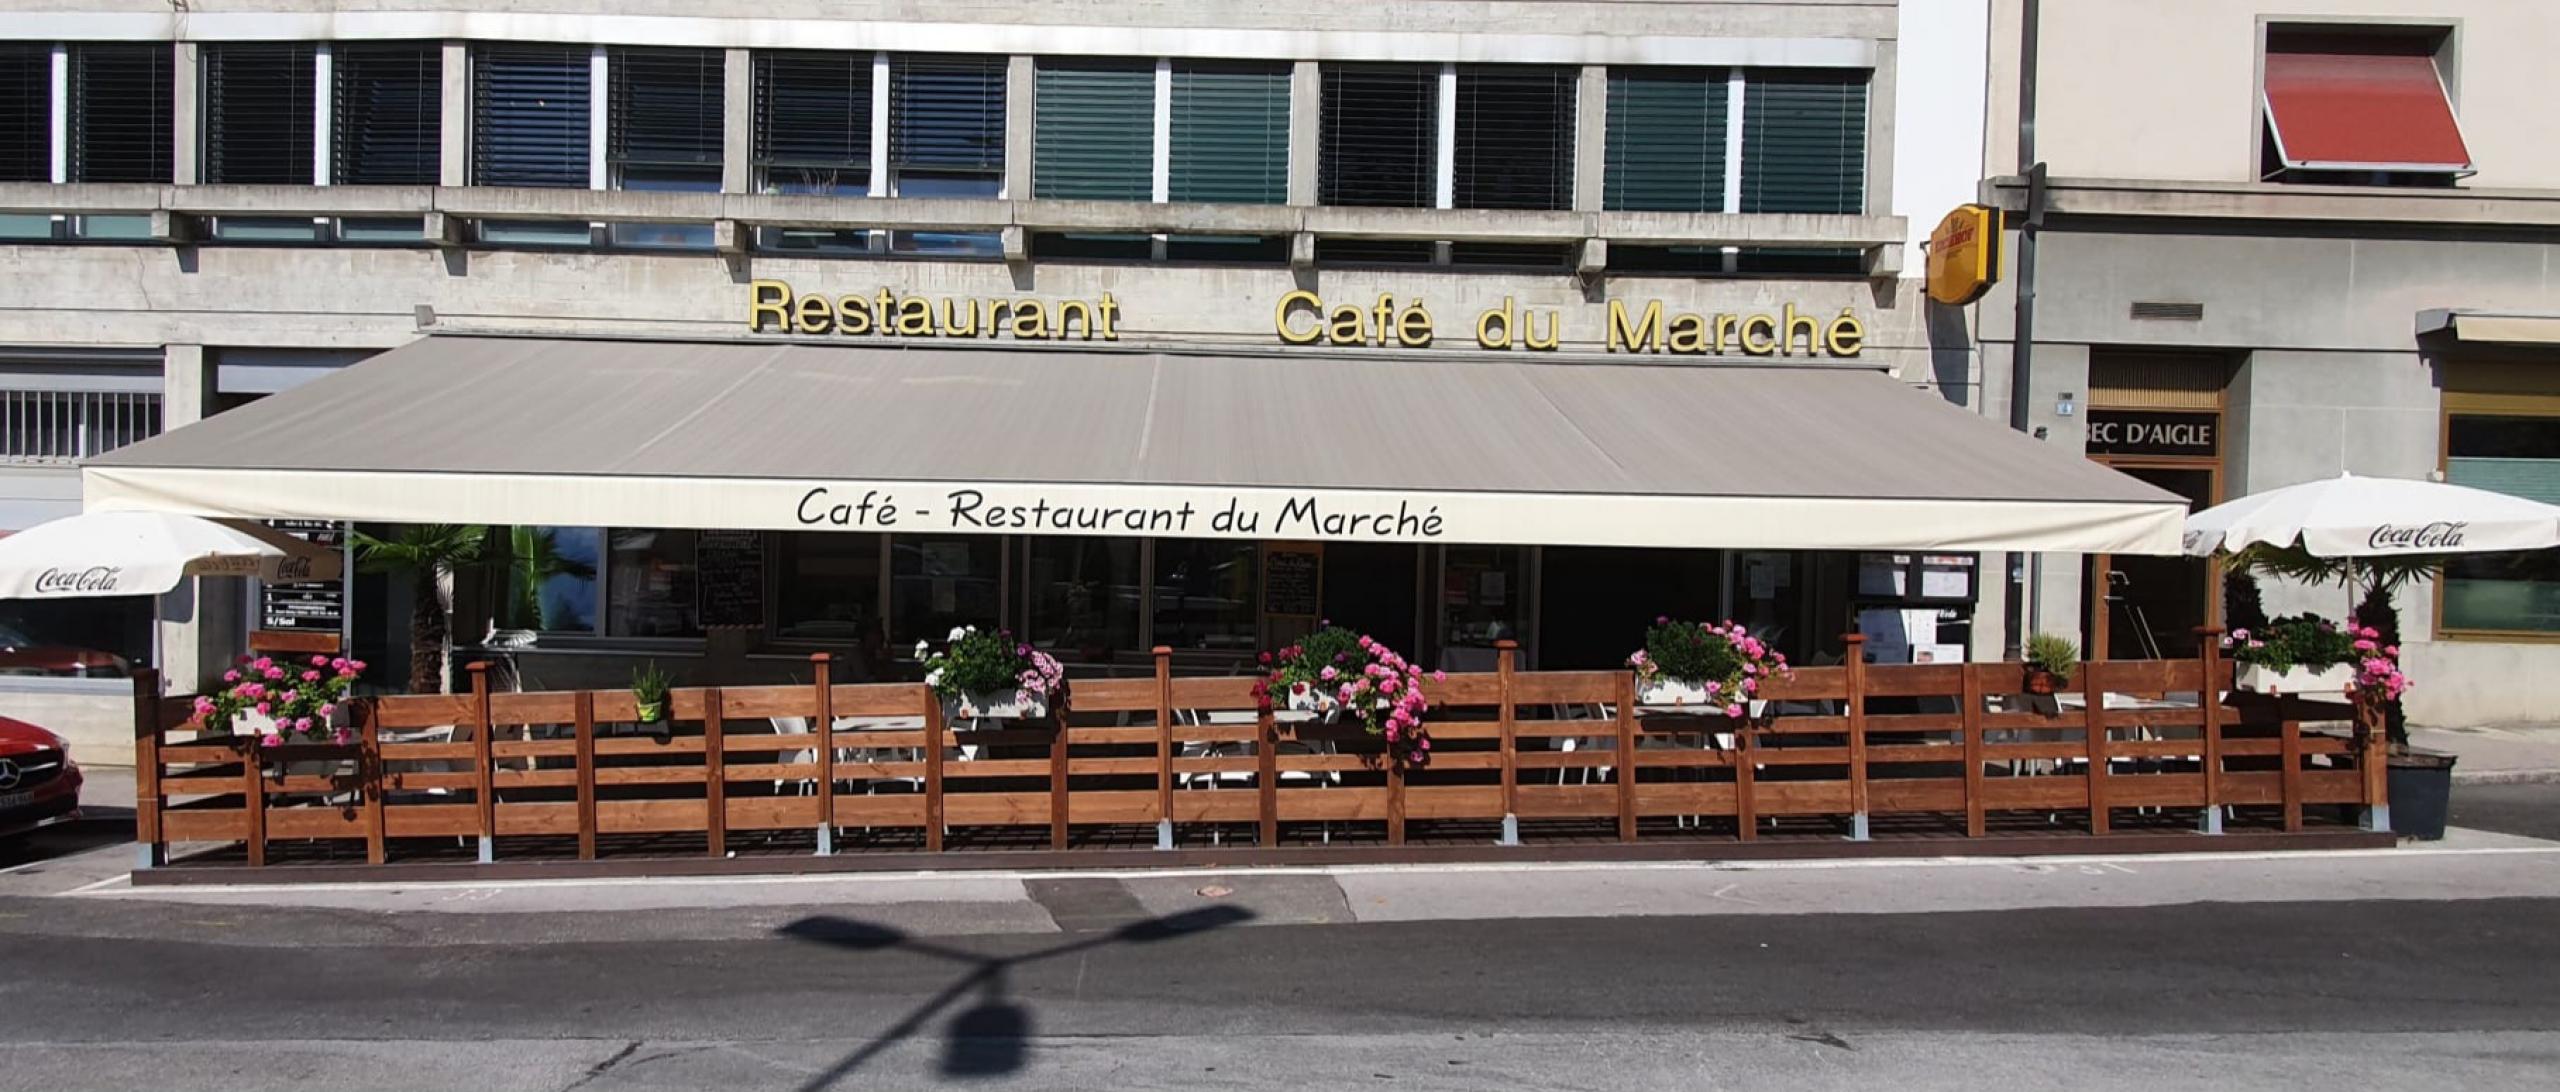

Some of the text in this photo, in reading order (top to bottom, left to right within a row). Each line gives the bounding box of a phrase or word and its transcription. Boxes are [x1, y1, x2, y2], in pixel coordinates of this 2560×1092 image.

[748, 278, 1866, 357] Restaurant Café du Marché
[2126, 423, 2211, 446] D'AIGLE
[797, 487, 897, 526] Café
[947, 489, 1195, 531] Restaurant
[1211, 497, 1259, 533] du
[1275, 497, 1443, 536] Marché
